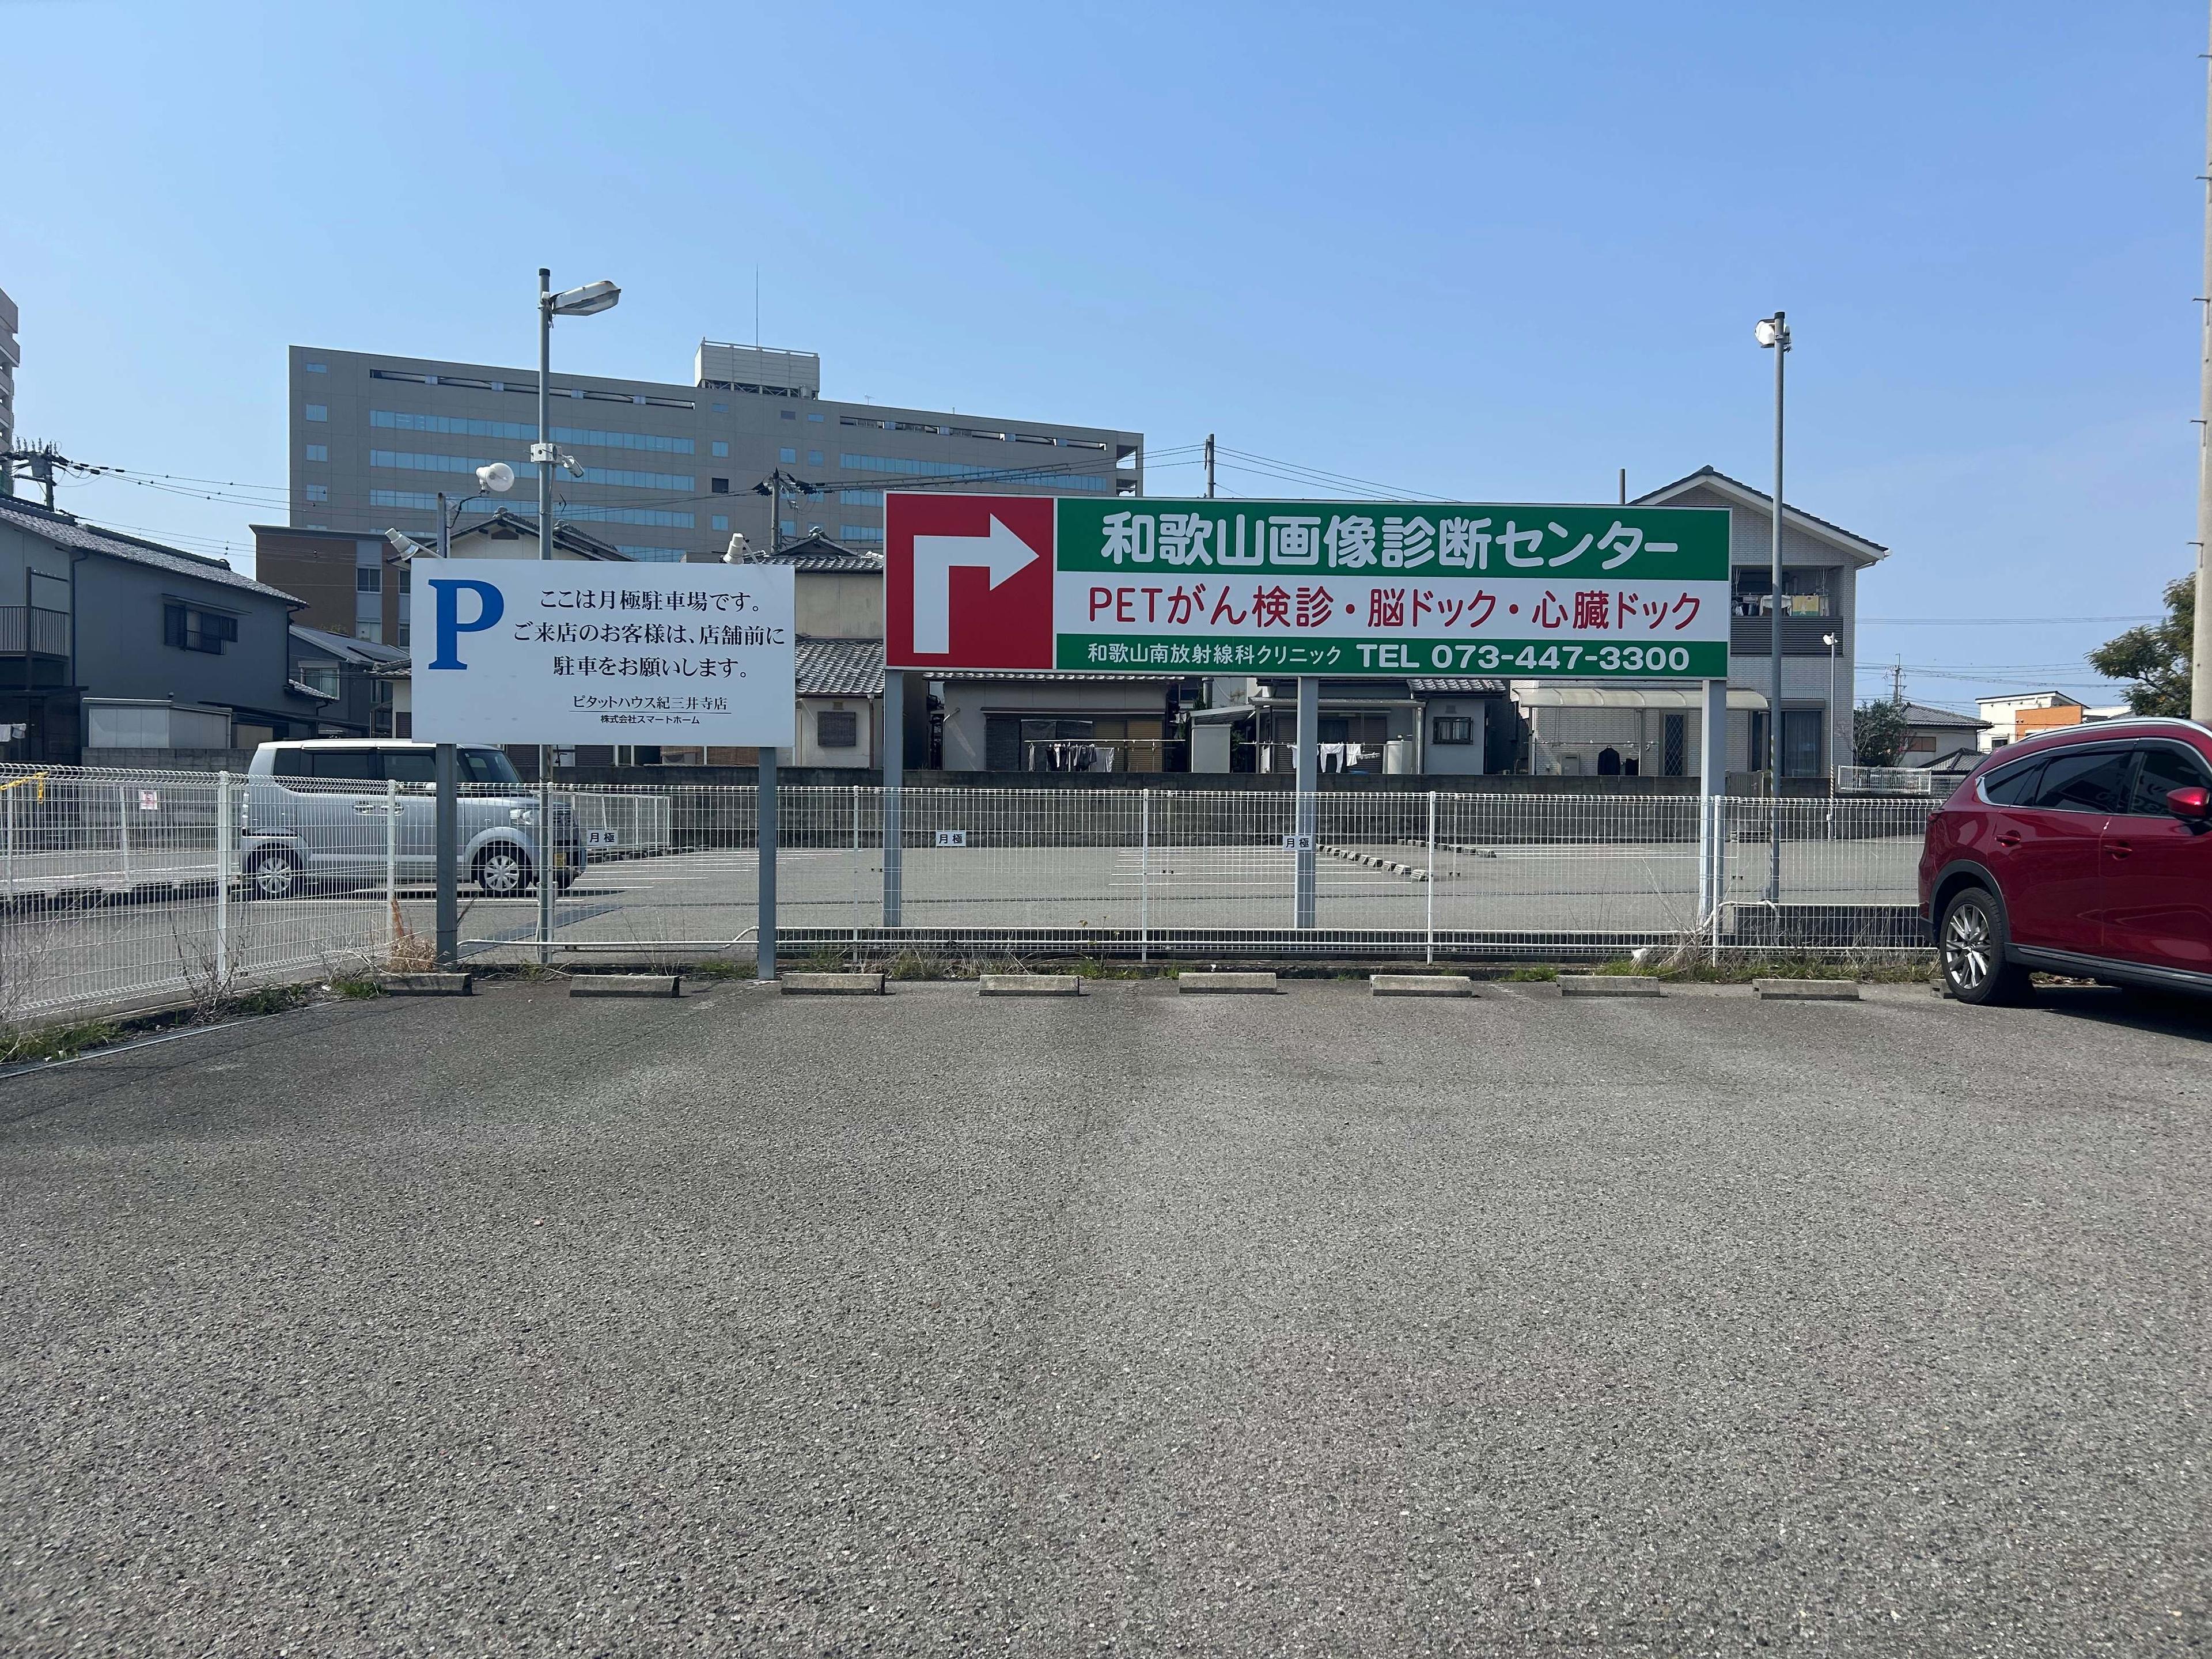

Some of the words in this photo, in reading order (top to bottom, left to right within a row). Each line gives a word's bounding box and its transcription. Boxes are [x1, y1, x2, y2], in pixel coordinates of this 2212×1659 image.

[1100, 511, 1678, 570] 和歌山画像診断センター
[540, 589, 759, 612] ここは月極駐車場です。
[427, 578, 505, 671] P
[514, 621, 785, 646] ご来店のお客様は、店舗前に
[552, 655, 747, 679] 駐車をお願いします。
[1088, 643, 1341, 665] 和歌山南放射線科クリニック
[1356, 644, 1420, 668] TEL
[1431, 644, 1690, 671] 073-447-3300
[573, 695, 728, 710] ピタットハウス紀三井寺店
[600, 714, 700, 725] 株式会社スマートホーム
[589, 832, 615, 843] 月極
[938, 834, 963, 844] 月極
[1286, 838, 1309, 848] 月極
